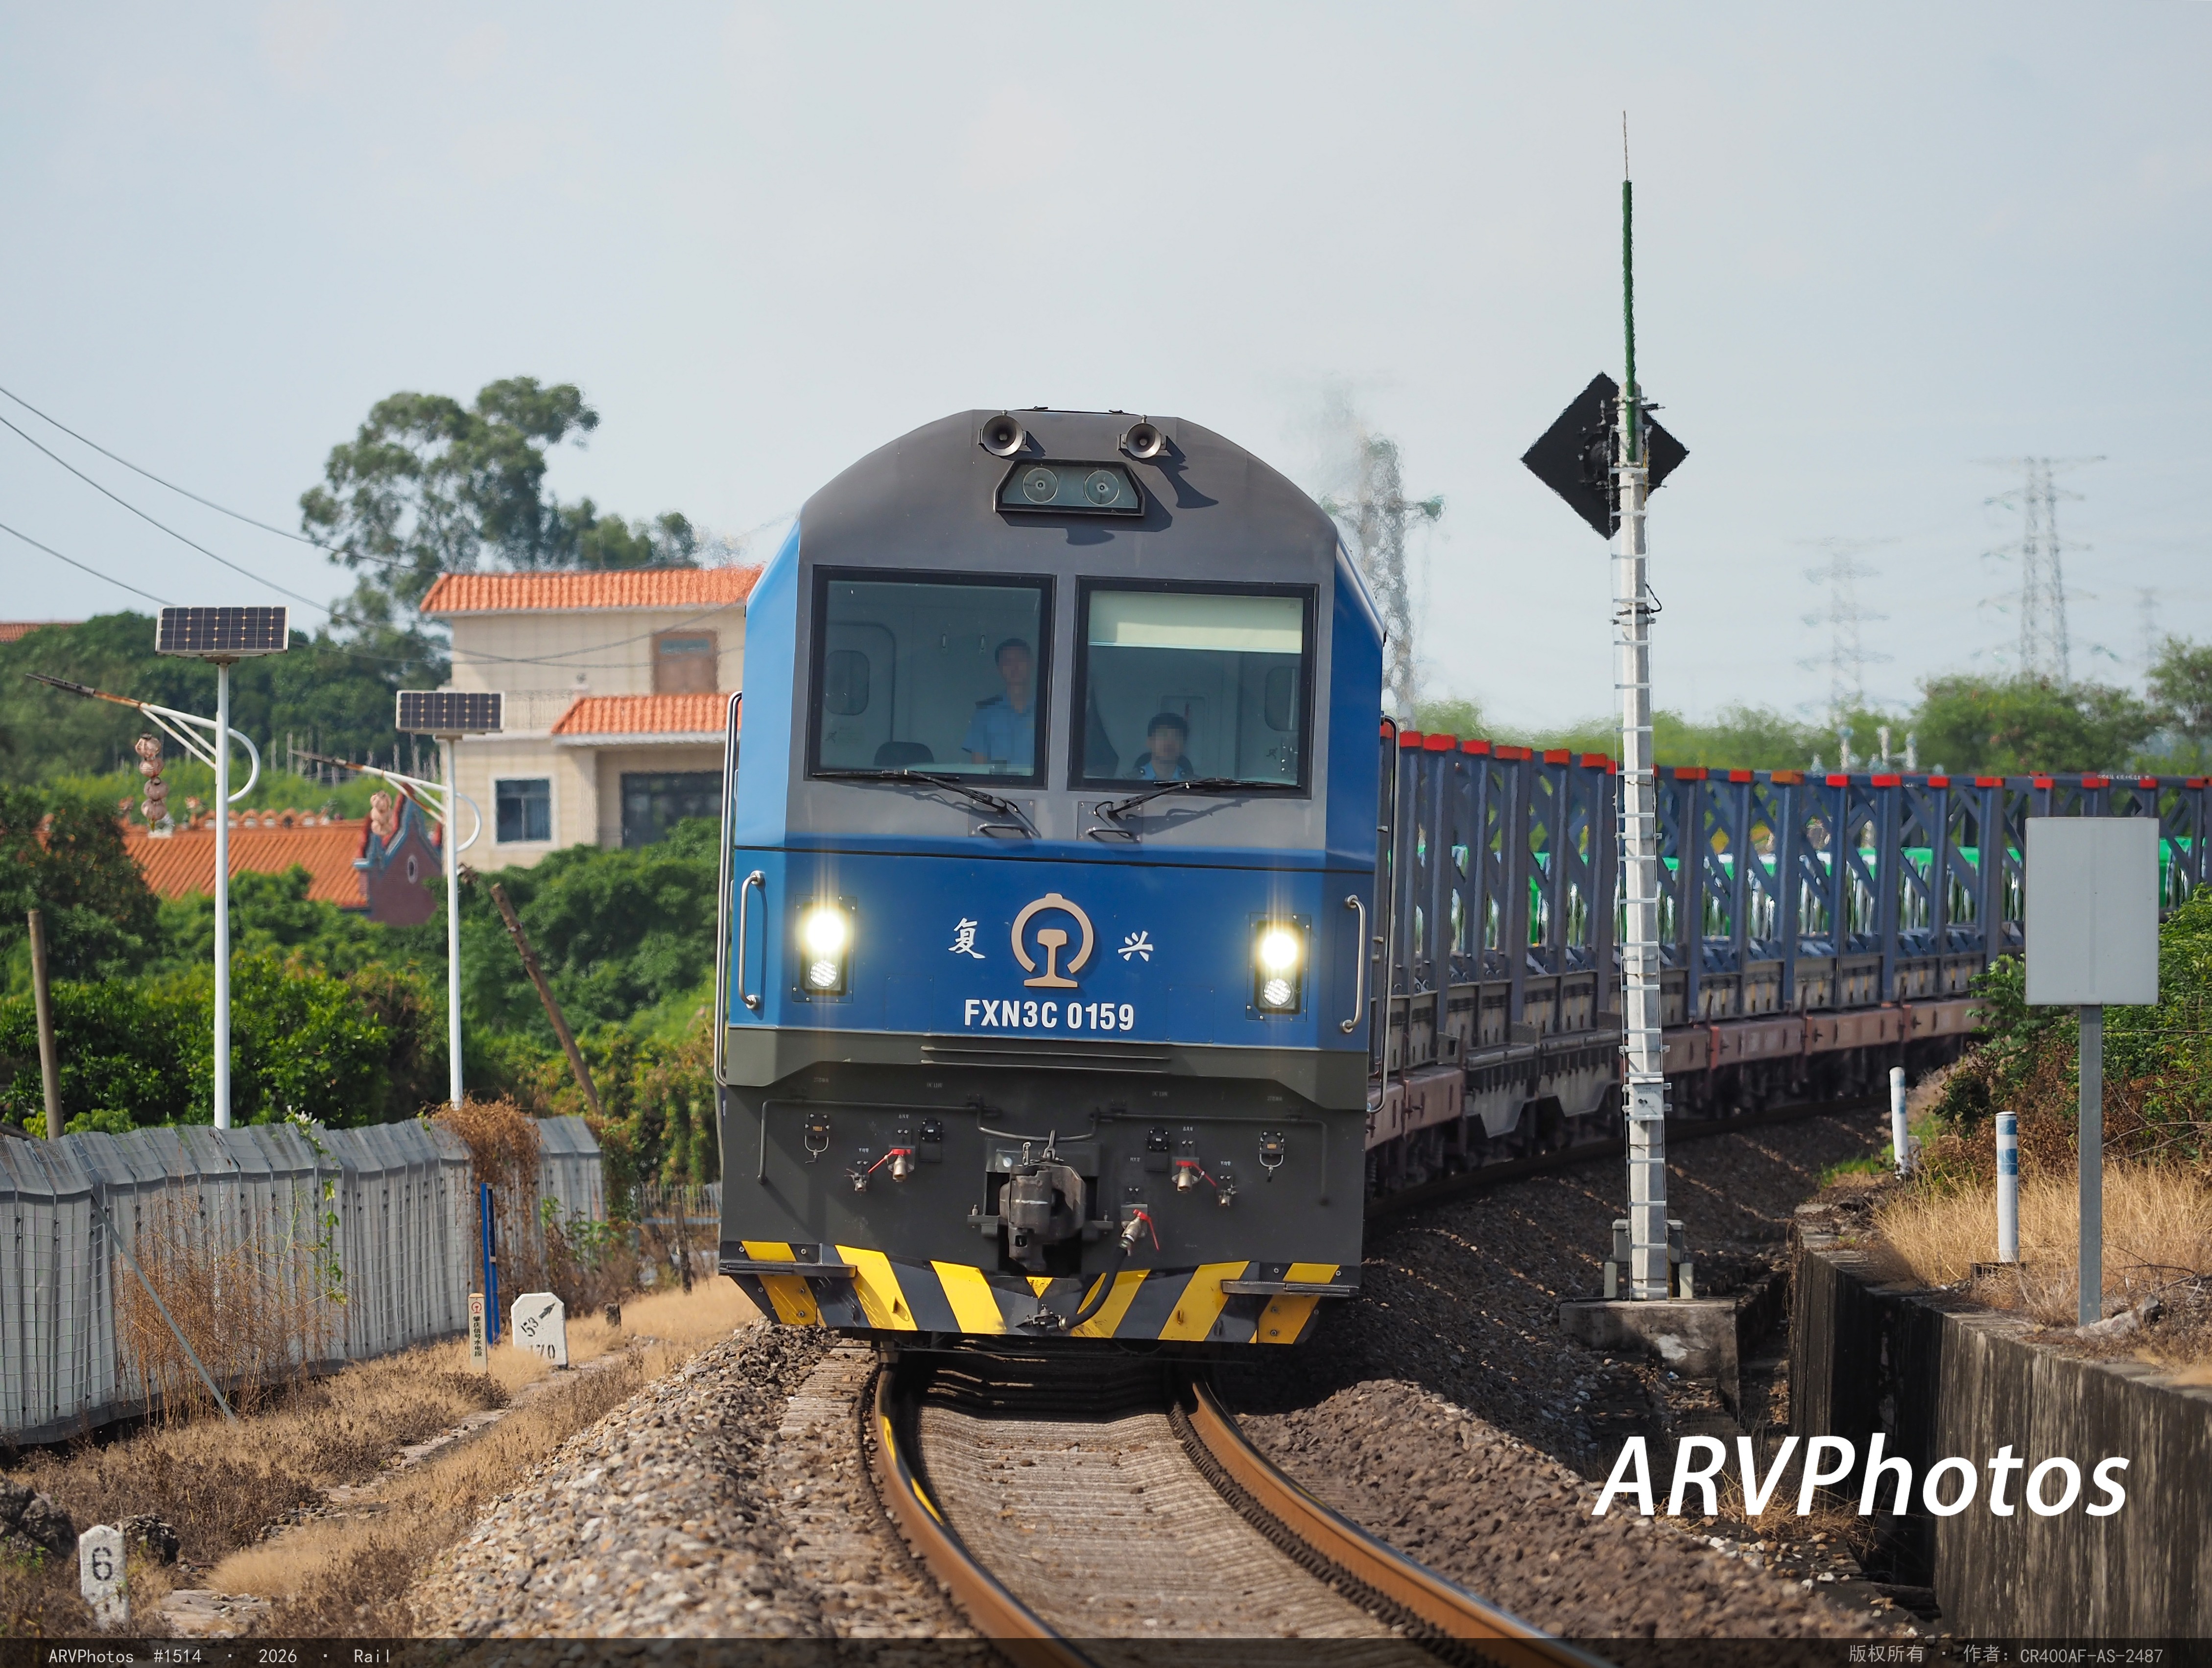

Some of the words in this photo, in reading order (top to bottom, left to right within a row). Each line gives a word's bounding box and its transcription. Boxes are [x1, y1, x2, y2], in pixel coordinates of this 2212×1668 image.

[948, 917, 985, 959] 复
[1118, 930, 1154, 962] 兴
[964, 999, 1057, 1028] FXN3C
[1067, 1002, 1134, 1030] 0159
[520, 1316, 539, 1337] 53
[93, 1546, 113, 1581] 6
